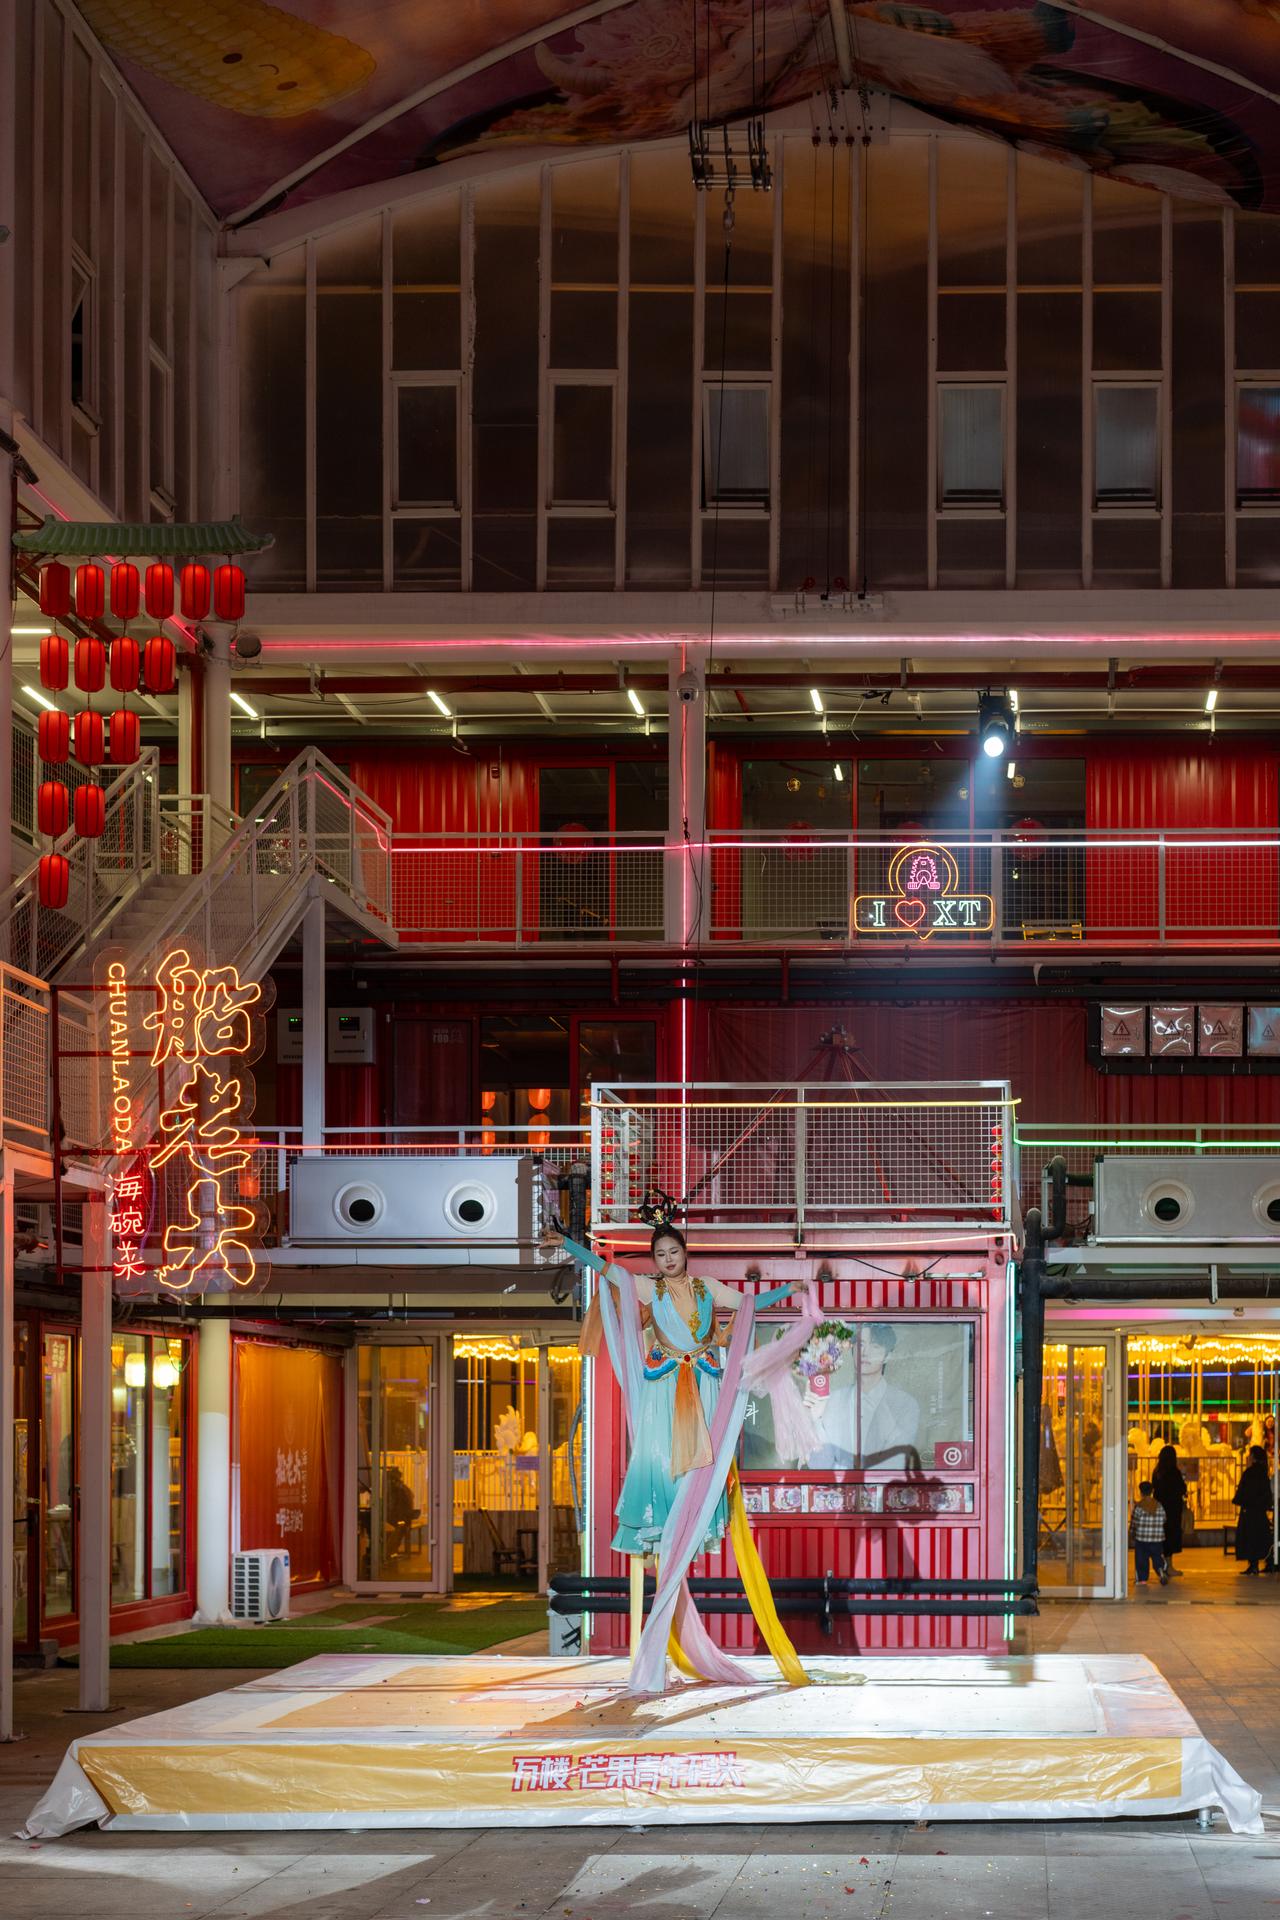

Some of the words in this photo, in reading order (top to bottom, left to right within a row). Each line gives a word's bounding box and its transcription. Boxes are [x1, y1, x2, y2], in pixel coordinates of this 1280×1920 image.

[873, 901, 886, 927] I
[932, 900, 981, 926] XT
[108, 963, 133, 1154] CHUANLAODA
[144, 949, 261, 1289] 船老大
[104, 1171, 146, 1281] 海碗菜
